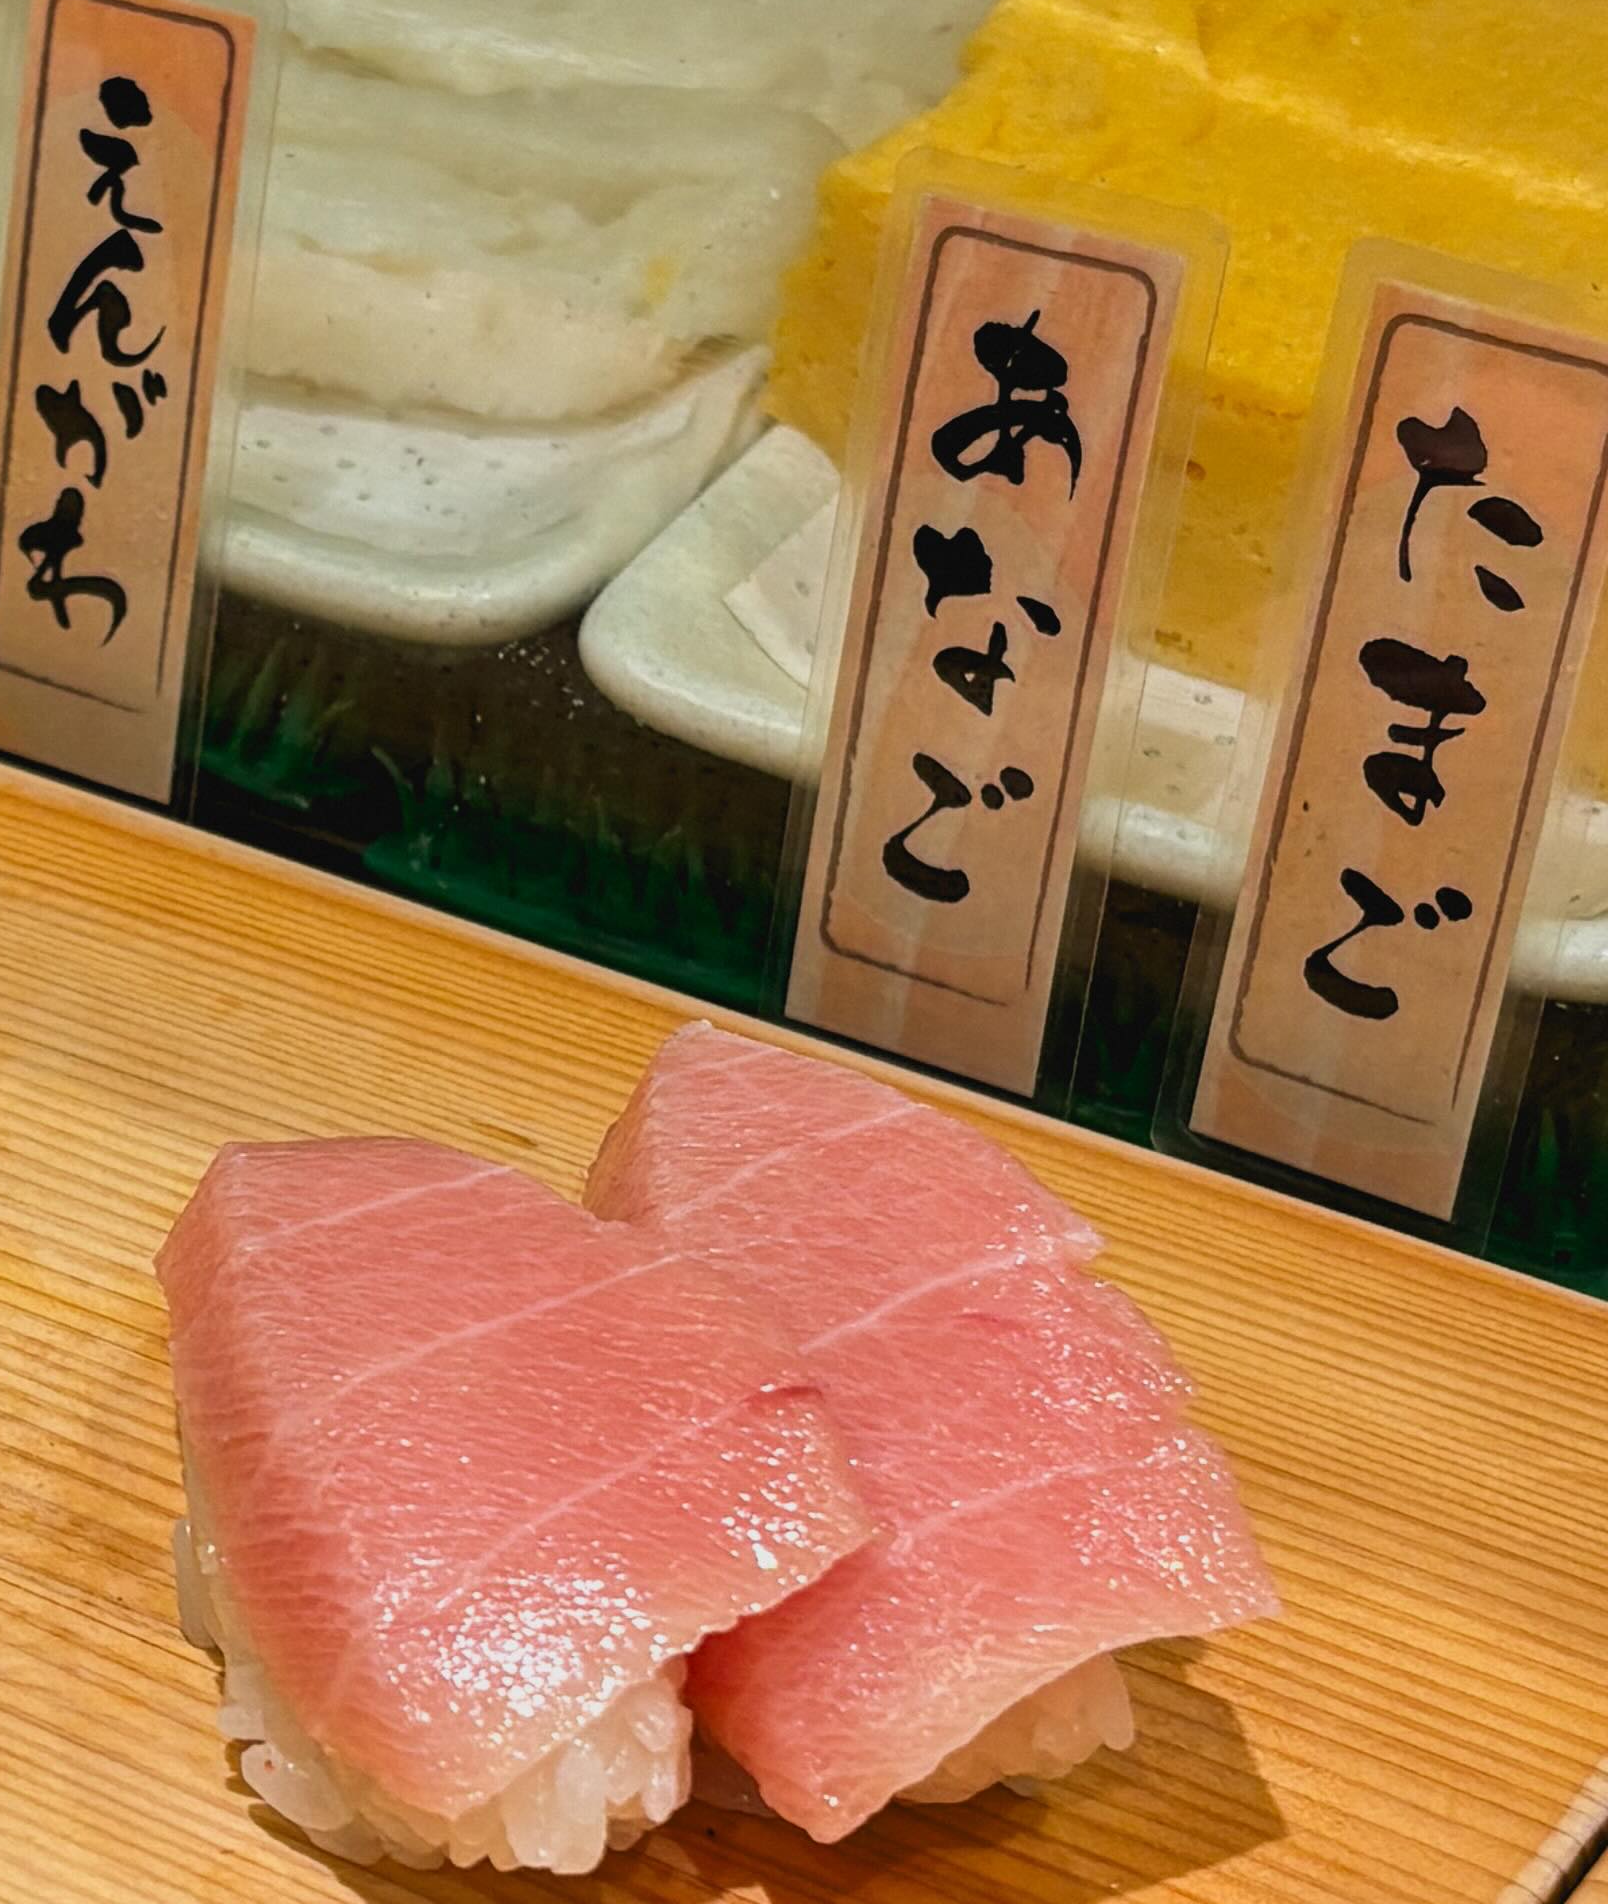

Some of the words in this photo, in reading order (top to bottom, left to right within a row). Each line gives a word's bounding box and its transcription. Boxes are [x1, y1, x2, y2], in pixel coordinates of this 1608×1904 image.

[19, 76, 167, 648] えんがわ
[882, 309, 1083, 903] あなご
[1304, 406, 1544, 1021] たまご
